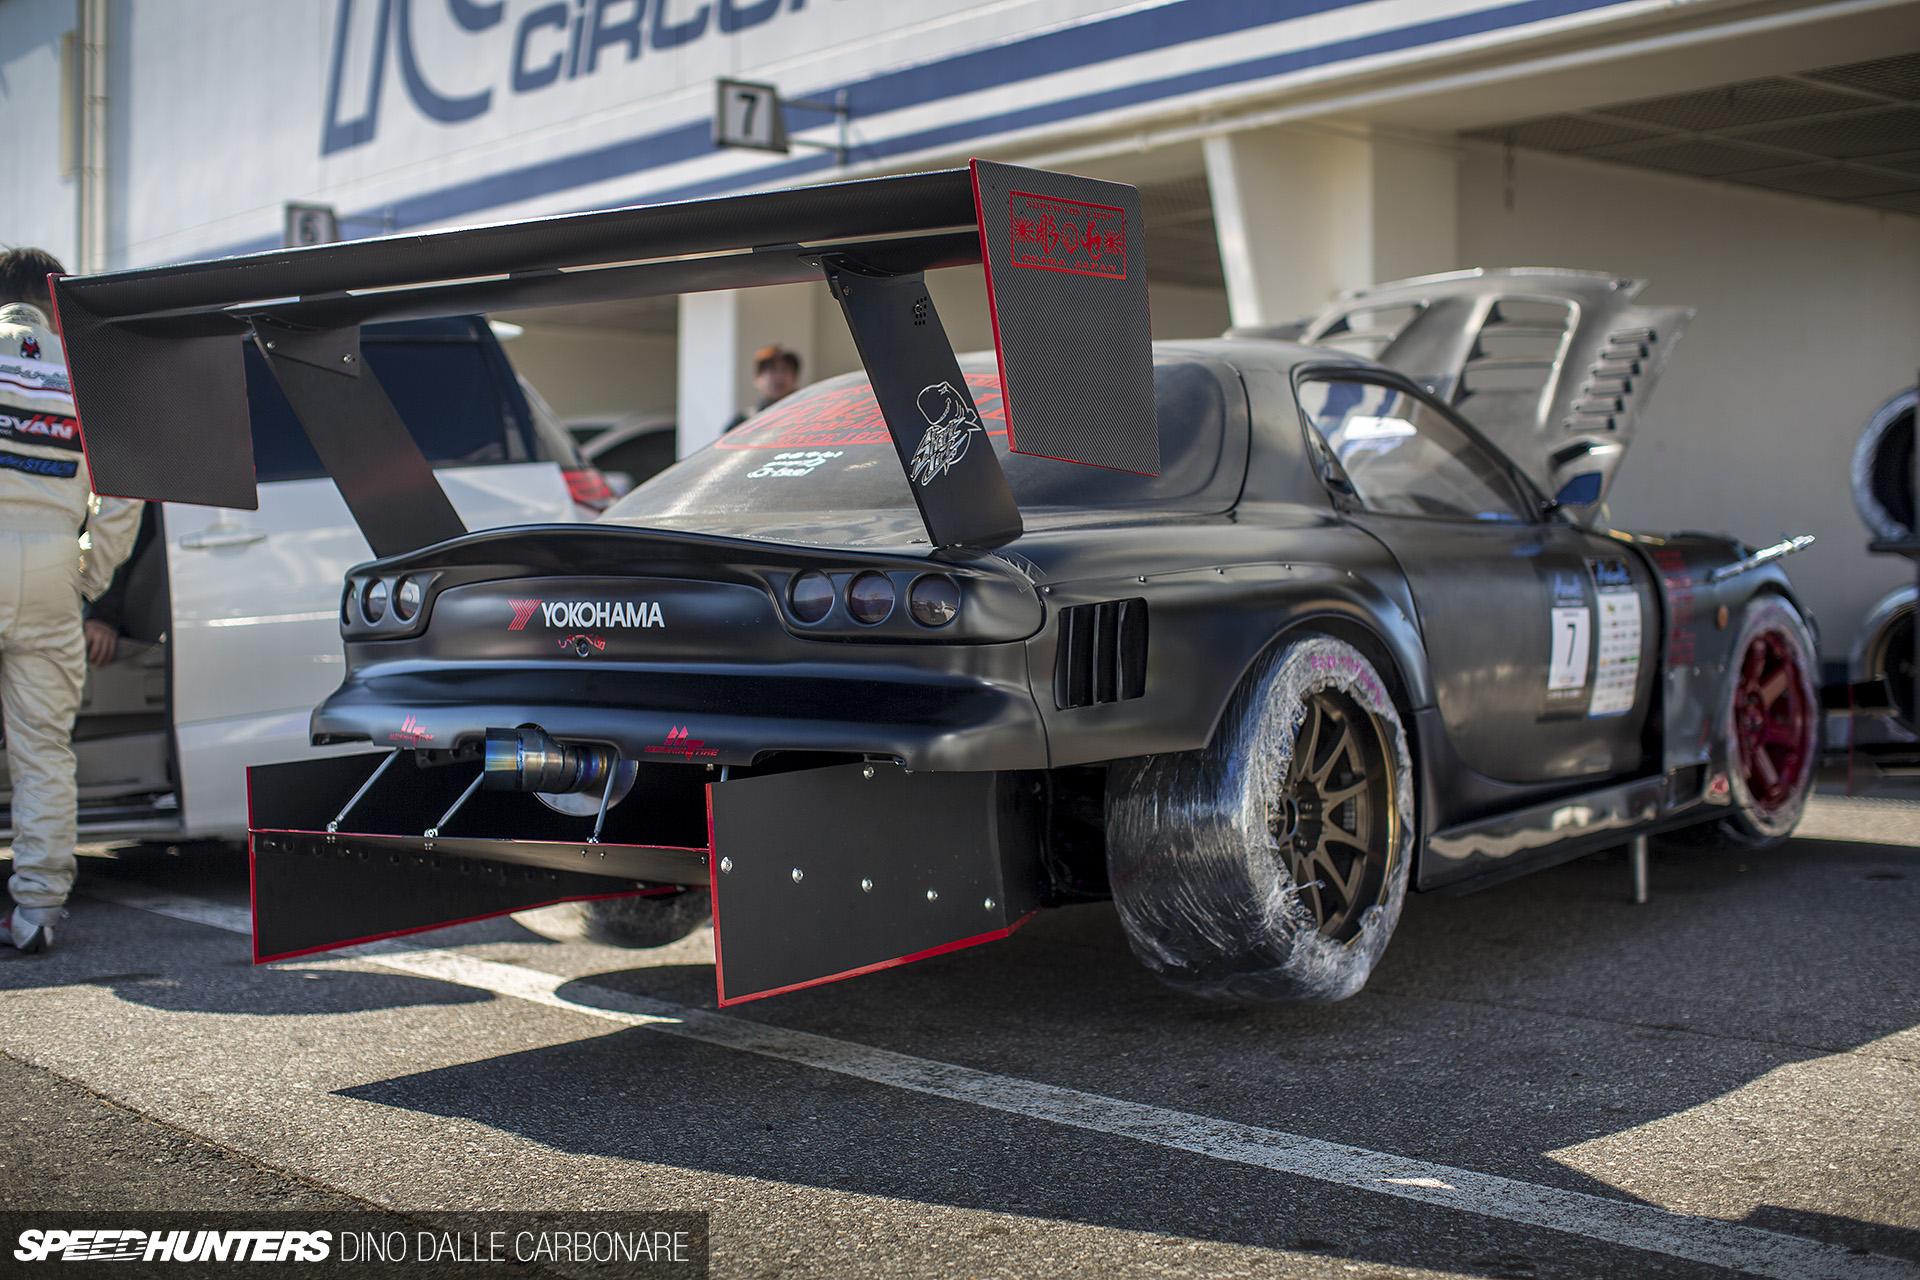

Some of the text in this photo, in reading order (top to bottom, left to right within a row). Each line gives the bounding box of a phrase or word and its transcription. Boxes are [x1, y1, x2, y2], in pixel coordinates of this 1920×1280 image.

[737, 93, 757, 137] 7
[1026, 200, 1061, 213] SUPER
[1087, 210, 1114, 221] CHOP
[1021, 255, 1116, 272] OSAKA JAPAN
[541, 602, 665, 628] YOKOHAMA
[1566, 622, 1576, 668] 7
[644, 745, 720, 757] MEISHIN TIRE
